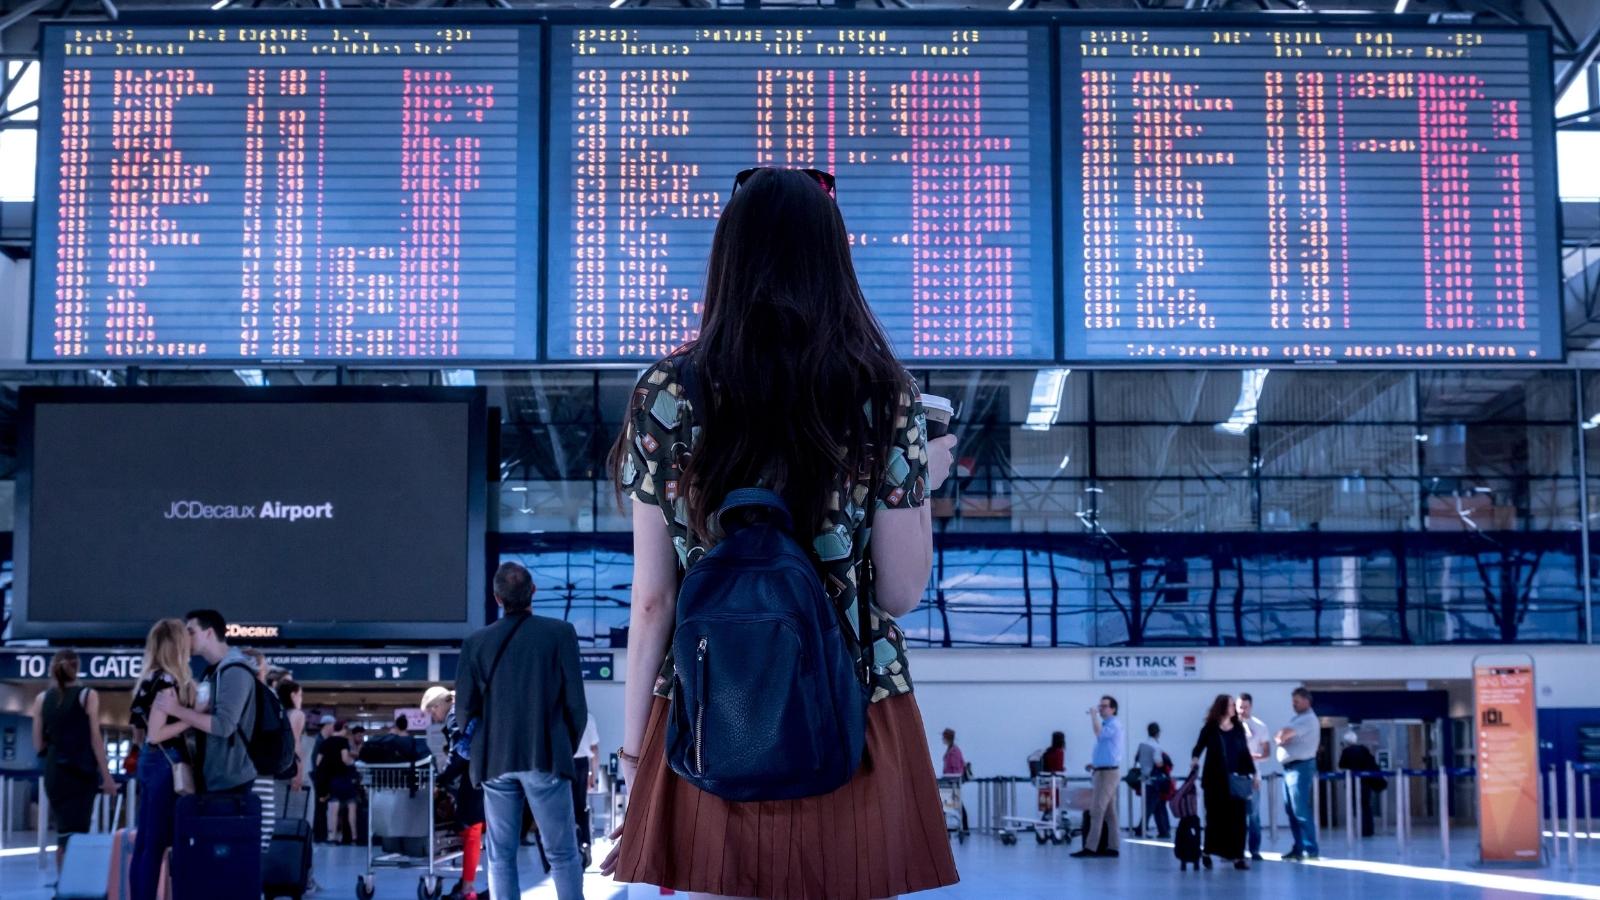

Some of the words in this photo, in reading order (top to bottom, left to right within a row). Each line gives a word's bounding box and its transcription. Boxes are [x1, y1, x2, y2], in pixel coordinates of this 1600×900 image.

[164, 501, 255, 519] JCDecaux
[259, 501, 333, 521] Airport
[225, 624, 279, 637] CDecaux
[16, 655, 45, 677] TO
[90, 655, 143, 678] GATE
[273, 656, 290, 664] YOUR
[323, 656, 337, 664] AND
[1099, 656, 1129, 667] FAST
[1136, 656, 1176, 667] TRACK
